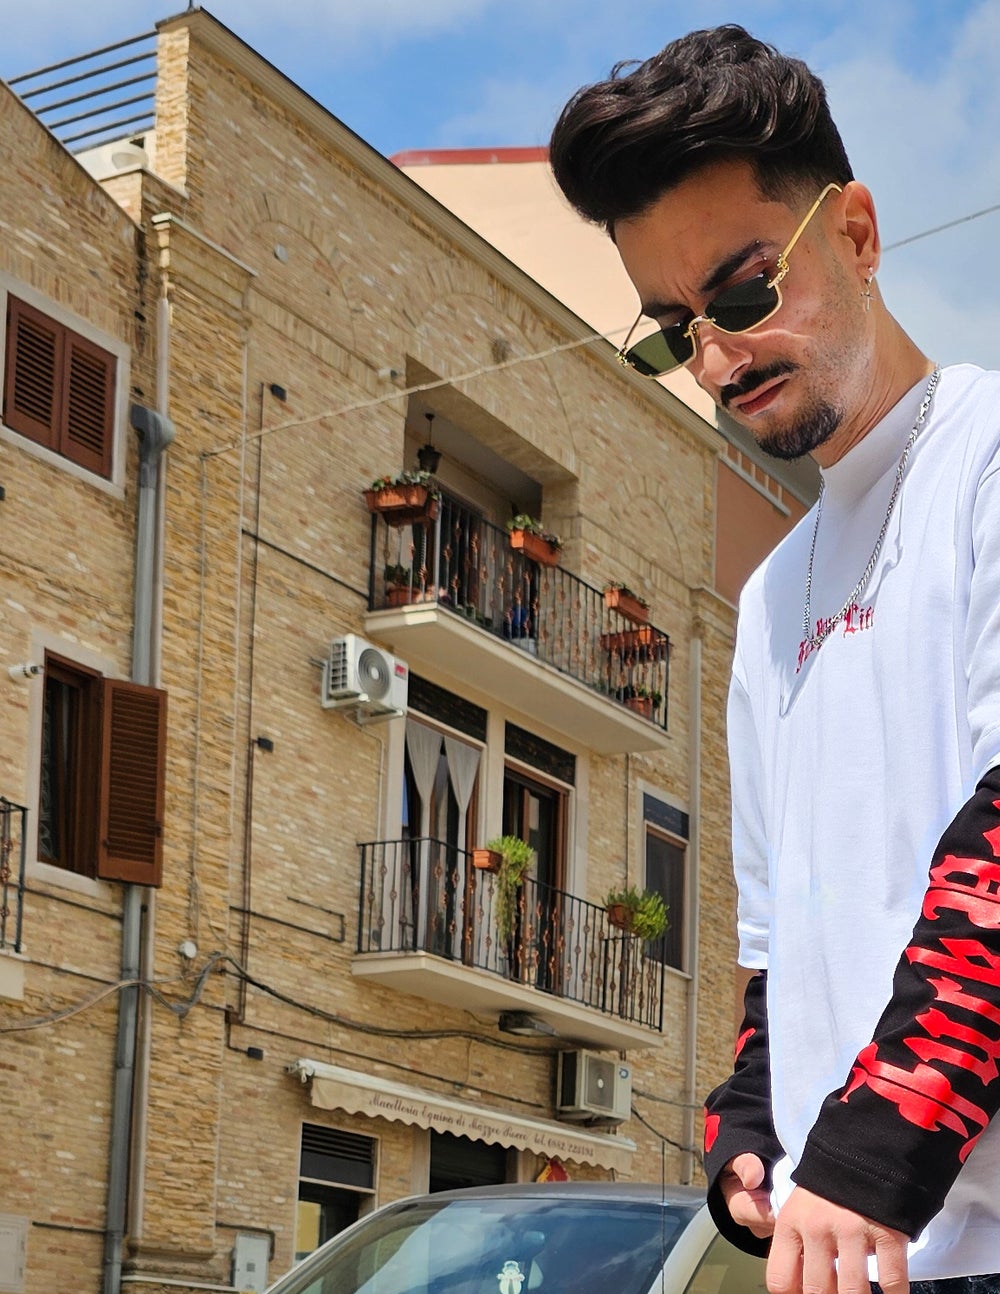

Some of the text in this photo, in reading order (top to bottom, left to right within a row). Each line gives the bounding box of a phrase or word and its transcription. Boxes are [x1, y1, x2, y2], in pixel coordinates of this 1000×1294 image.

[369, 1094, 418, 1118] Macelleria
[422, 1105, 454, 1125] Equina
[456, 1114, 466, 1127] di
